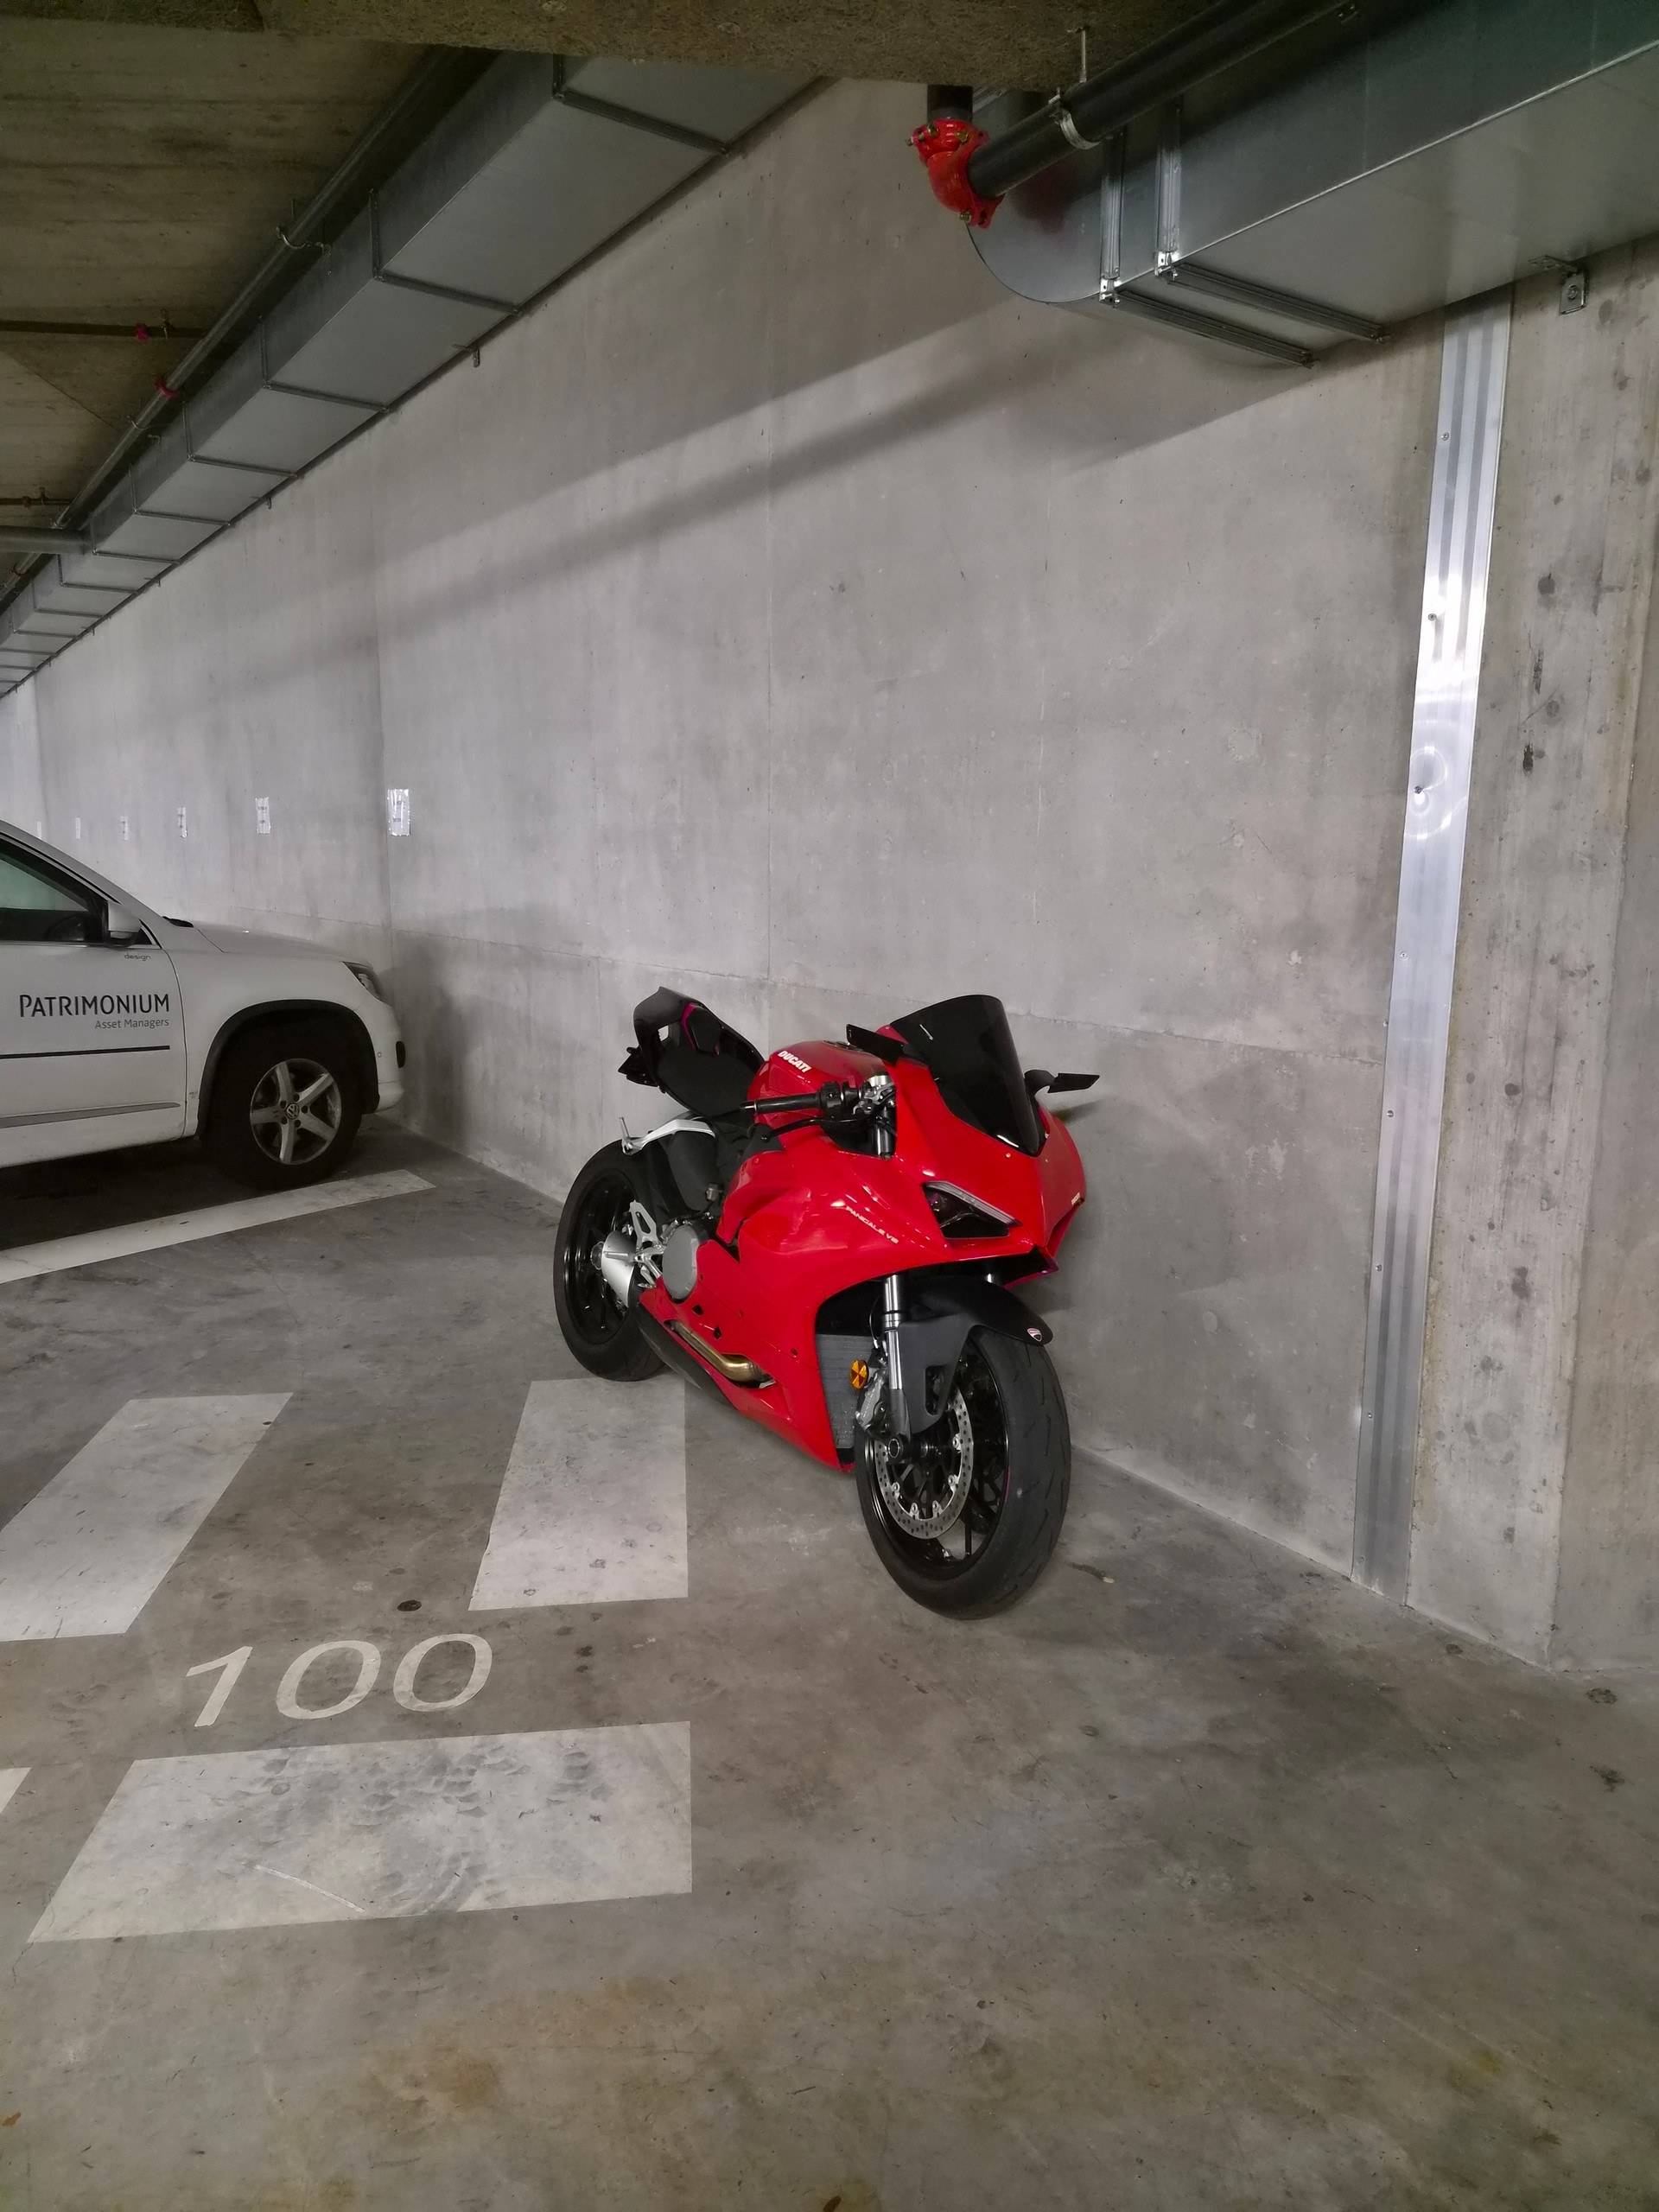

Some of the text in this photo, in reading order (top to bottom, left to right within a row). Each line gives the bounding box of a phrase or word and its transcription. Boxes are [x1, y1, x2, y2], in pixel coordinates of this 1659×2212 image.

[19, 994, 169, 1018] PATRIMONIUM
[94, 1019, 169, 1029] Asset Managers
[778, 1050, 812, 1073] DUCATI
[186, 1633, 493, 1728] 100
